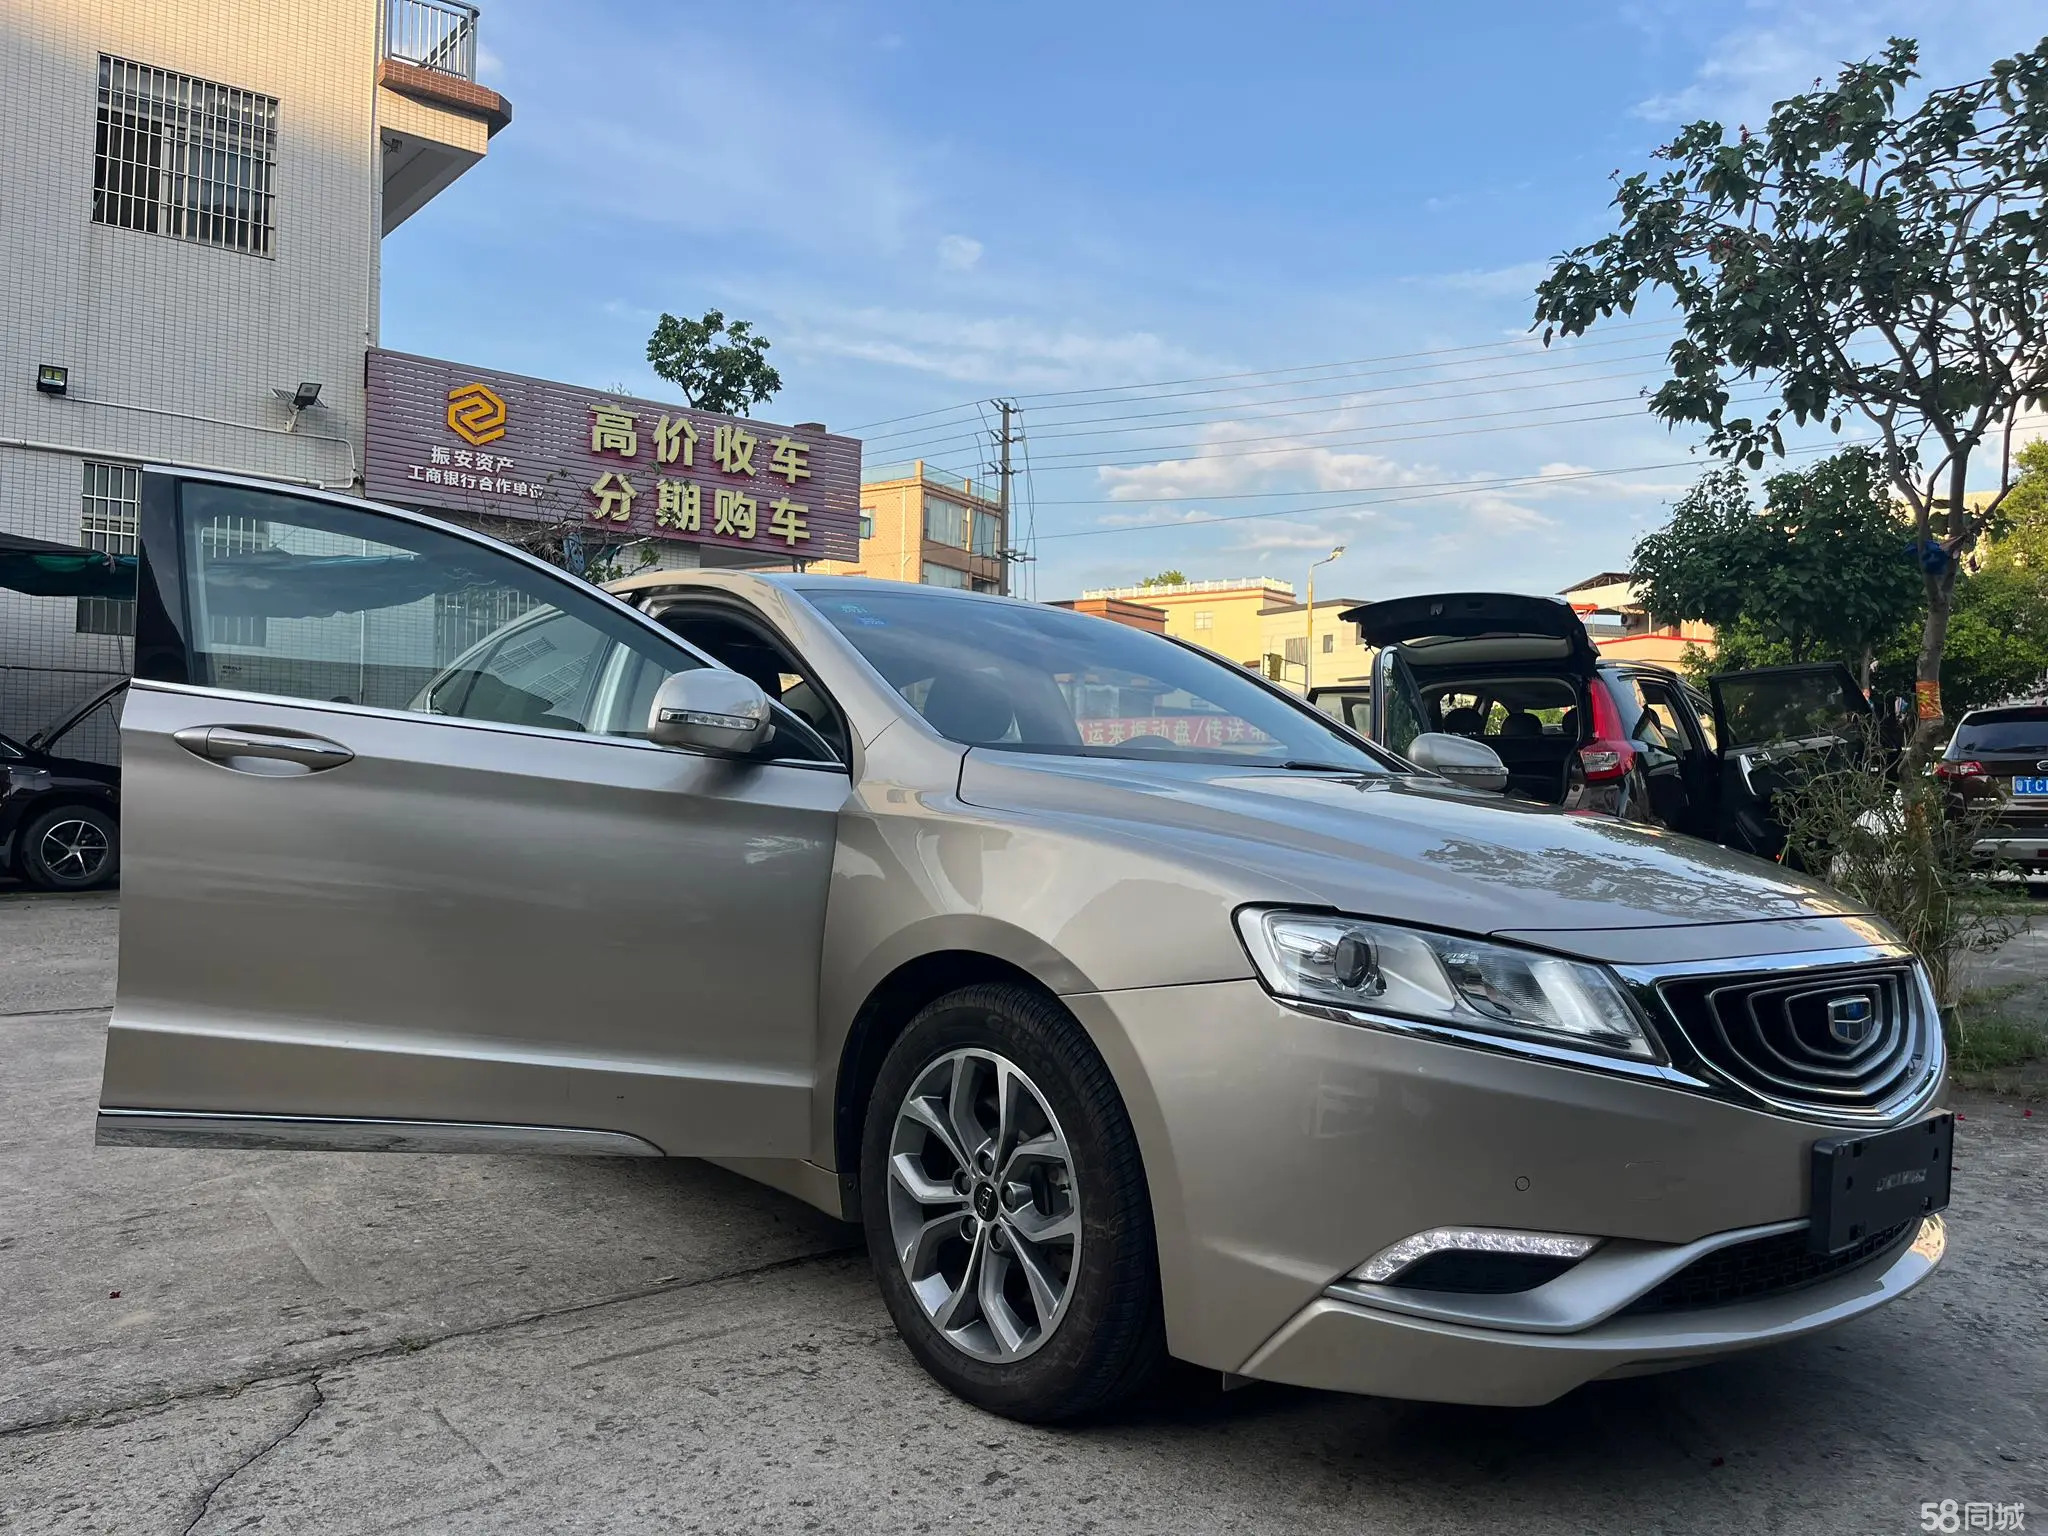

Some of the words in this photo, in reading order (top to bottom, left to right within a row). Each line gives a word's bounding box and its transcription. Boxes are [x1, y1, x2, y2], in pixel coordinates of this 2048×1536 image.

[431, 445, 514, 473] 振安资产
[590, 404, 811, 483] 高价收车
[407, 464, 545, 499] 工商银行合作单位
[591, 471, 811, 545] 分期购车
[1077, 718, 1268, 747] 运来振动盘/传送
